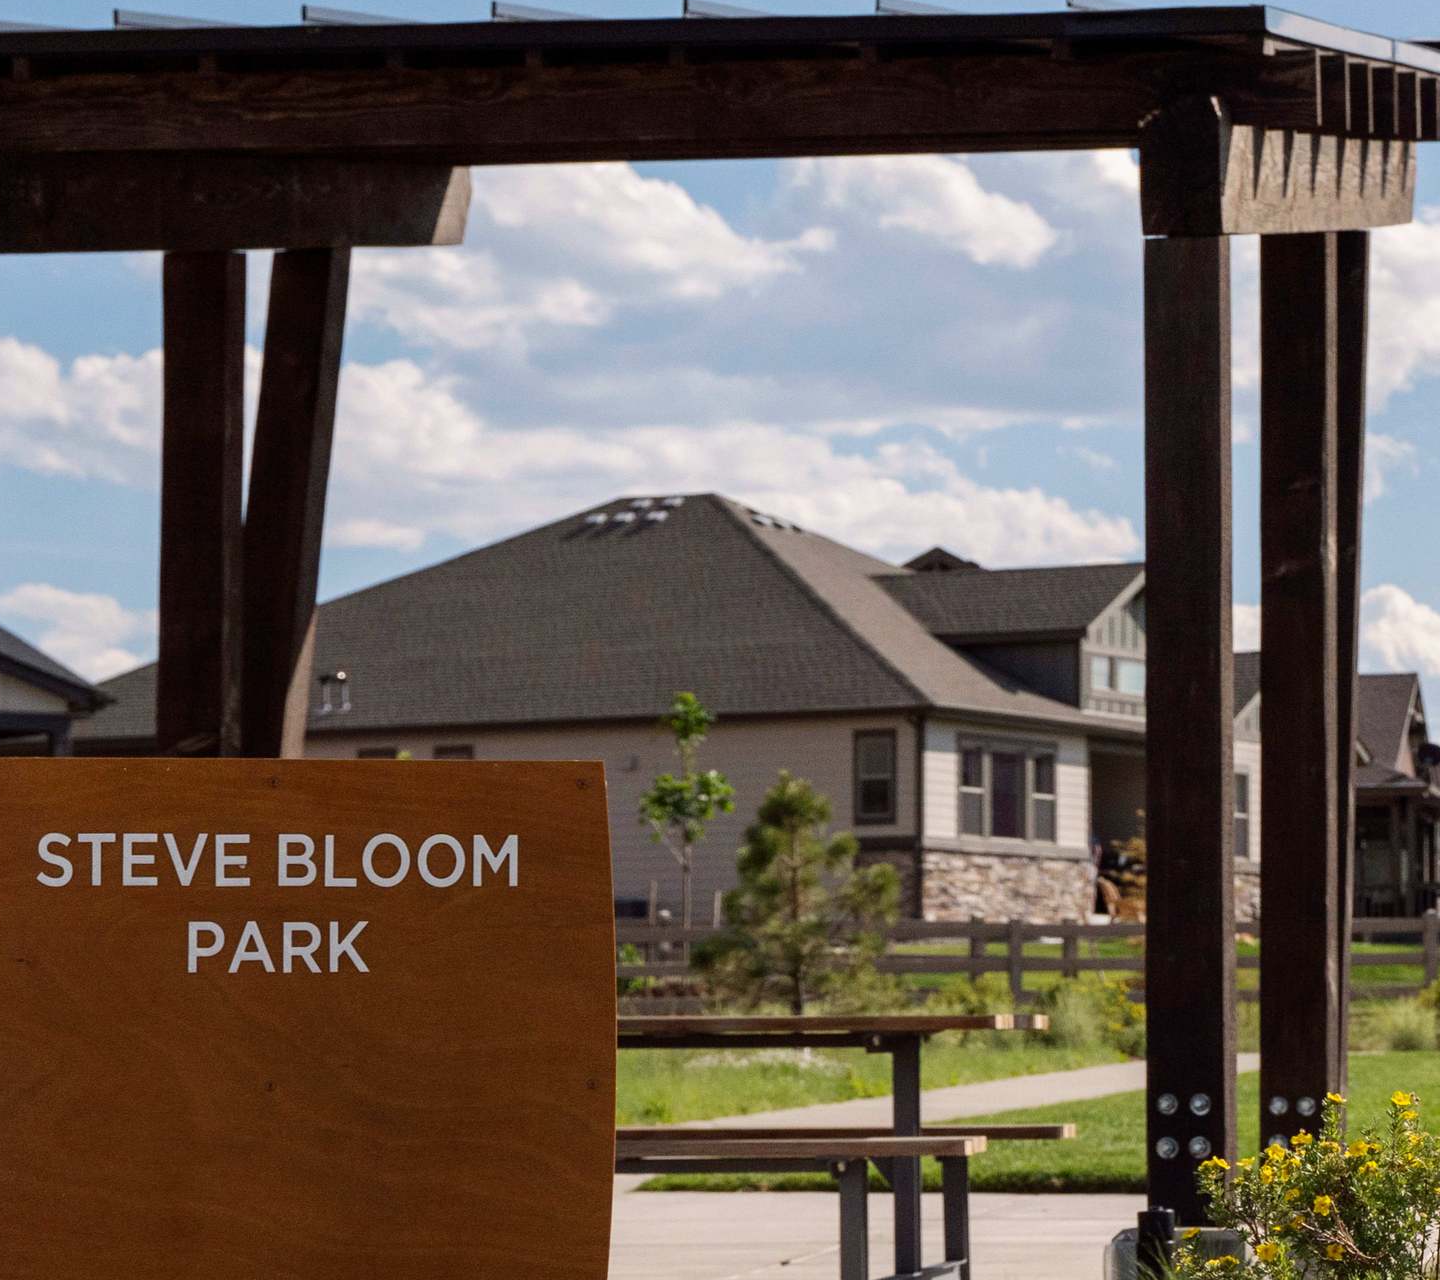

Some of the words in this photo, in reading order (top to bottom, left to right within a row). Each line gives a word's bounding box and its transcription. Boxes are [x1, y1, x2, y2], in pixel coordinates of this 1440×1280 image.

[36, 832, 251, 888] STEVE
[277, 832, 520, 888] BLOOM
[187, 920, 370, 974] PARK
